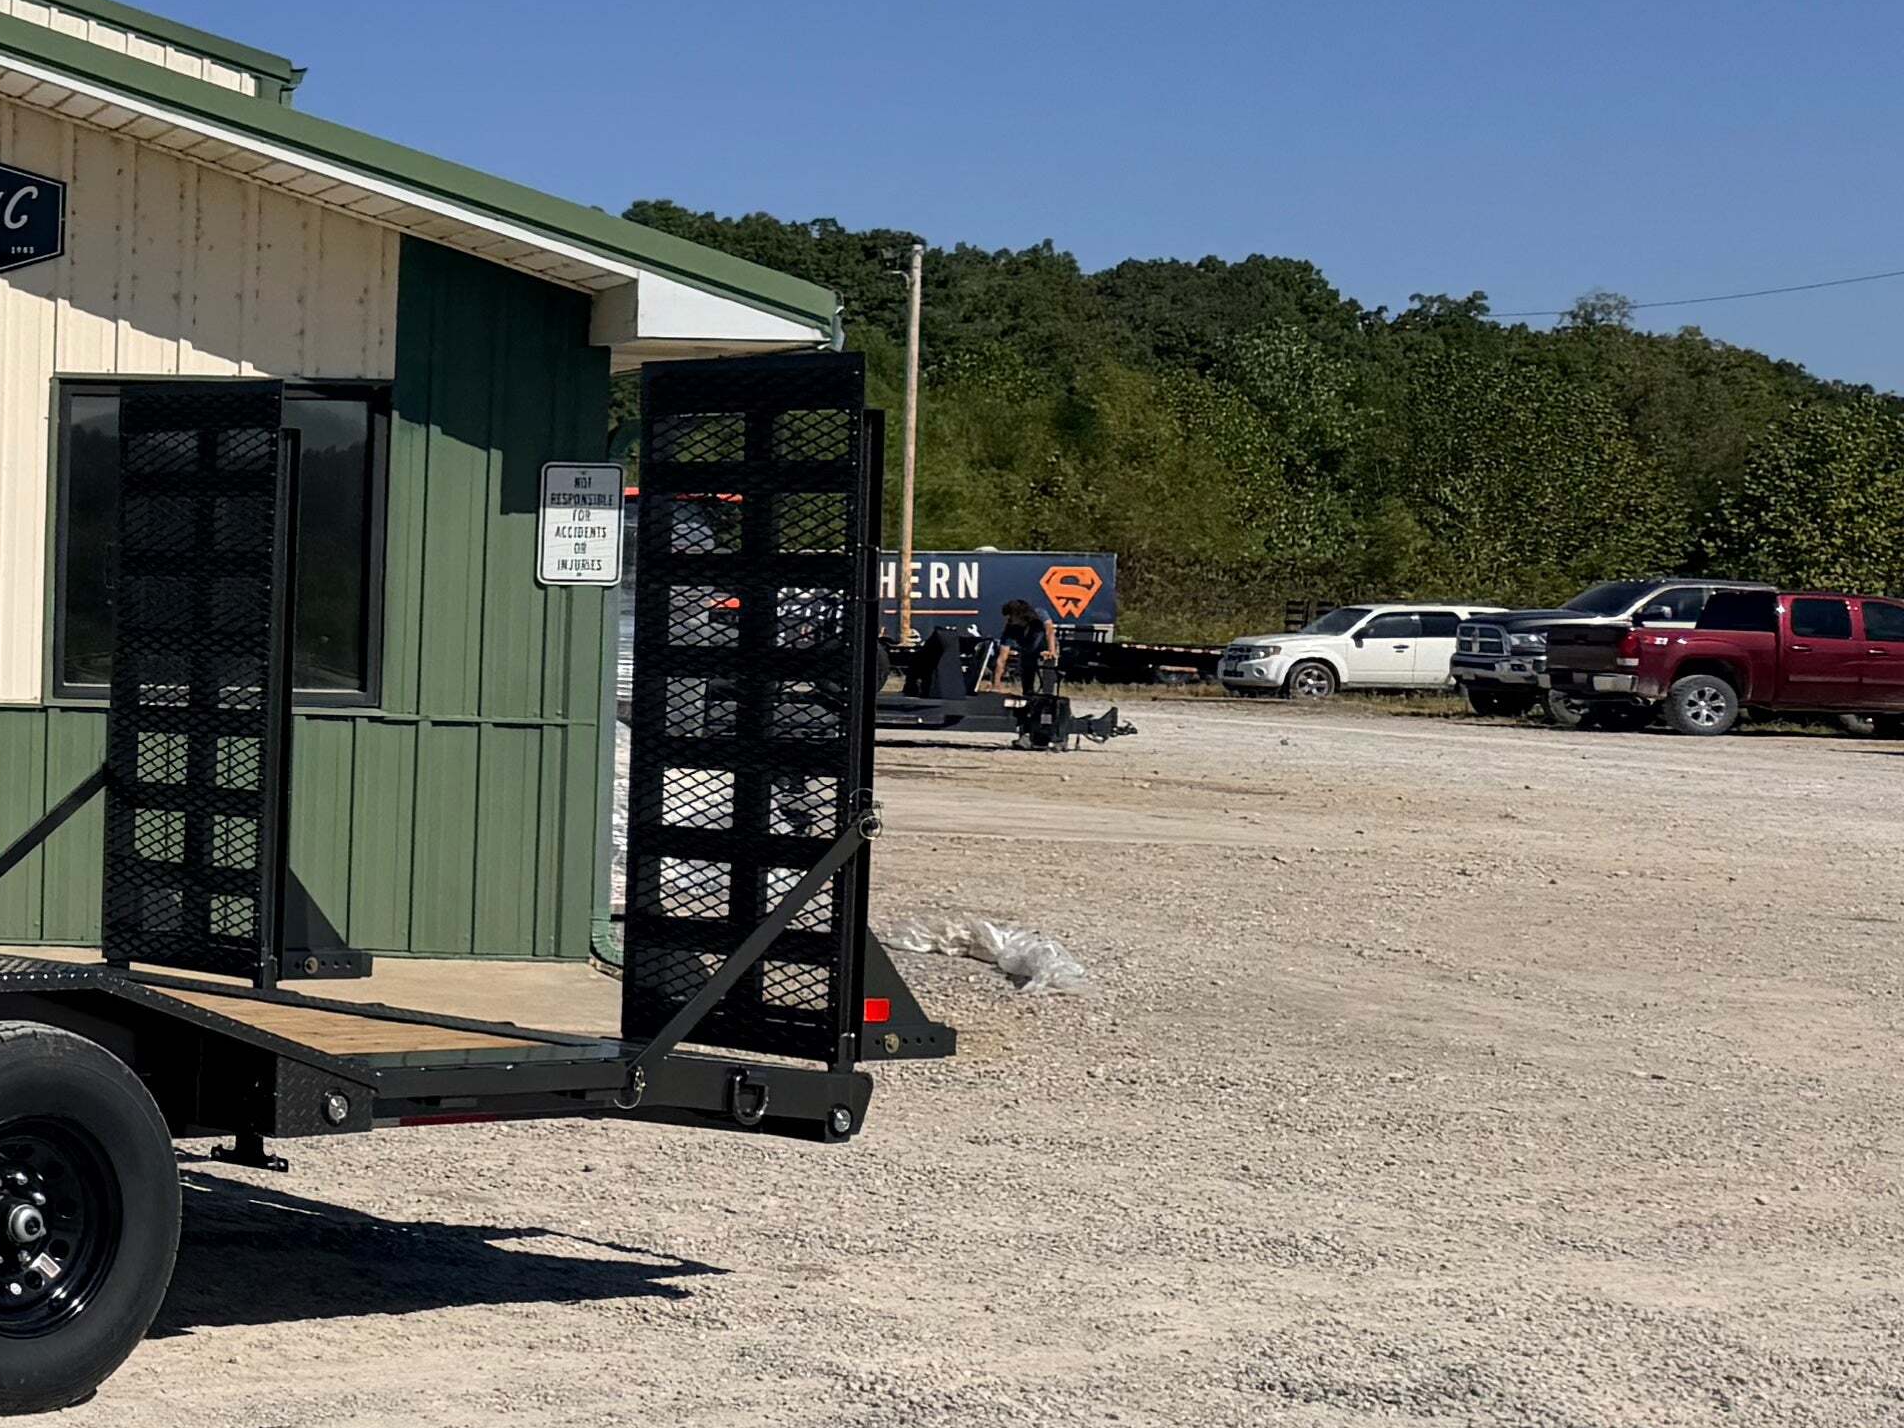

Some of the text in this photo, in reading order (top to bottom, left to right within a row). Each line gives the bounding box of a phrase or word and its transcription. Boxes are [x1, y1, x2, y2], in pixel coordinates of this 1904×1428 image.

[3, 185, 39, 230] C
[574, 476, 592, 489] NOT
[550, 492, 614, 507] RESPONSIBLE
[572, 509, 591, 522] FOR
[555, 525, 607, 539] ACCIDENTS
[573, 541, 587, 555] OR
[557, 558, 603, 571] INJURIES
